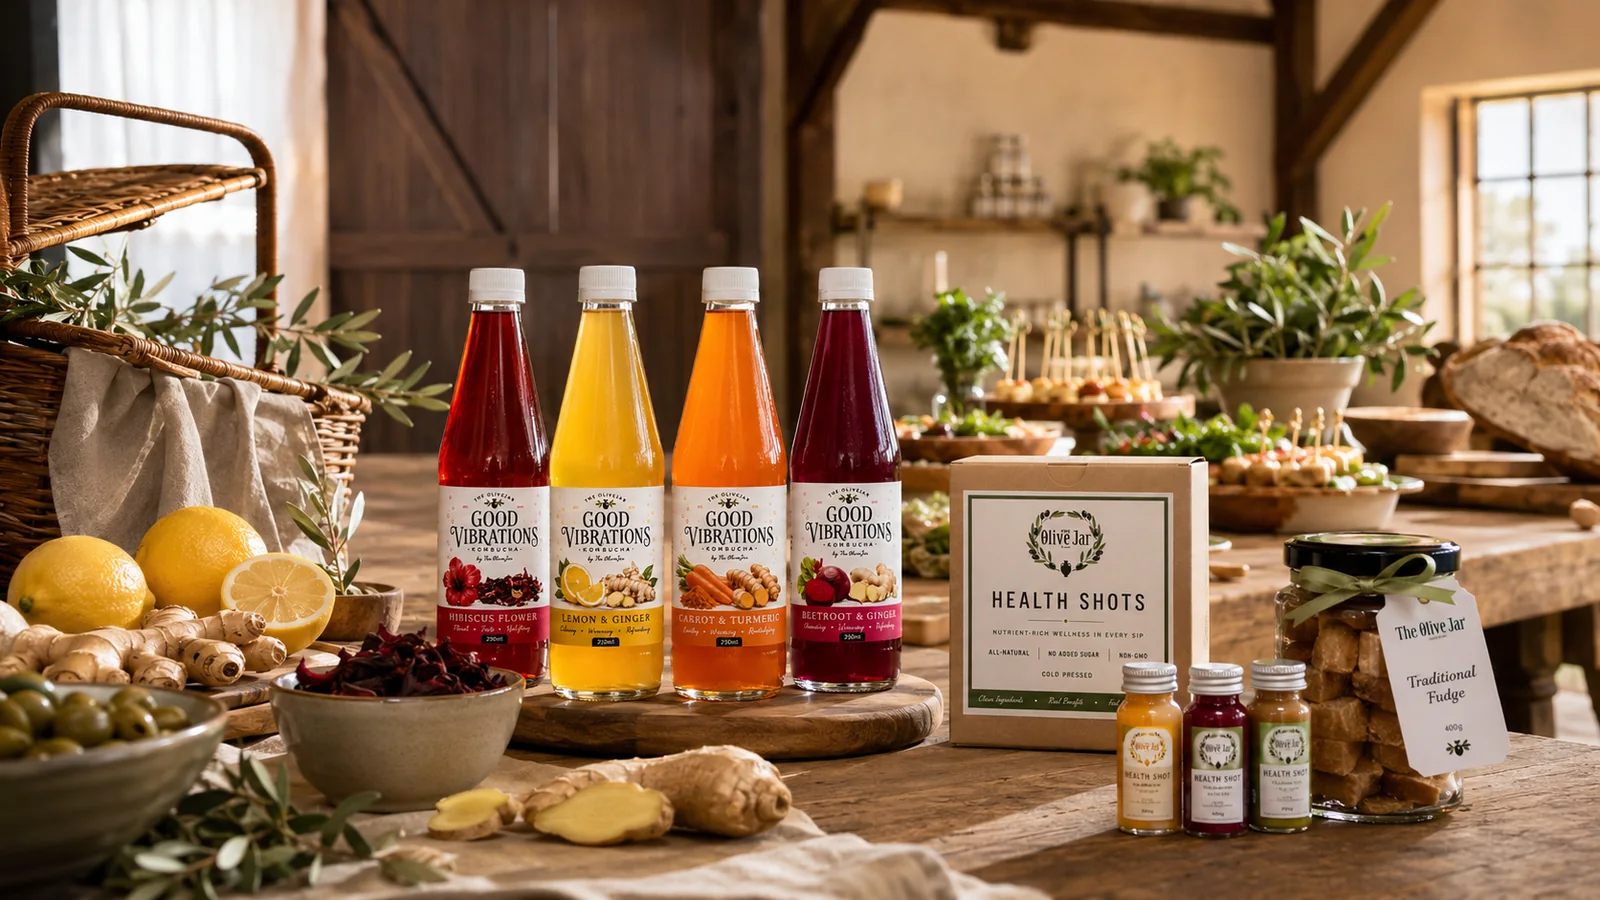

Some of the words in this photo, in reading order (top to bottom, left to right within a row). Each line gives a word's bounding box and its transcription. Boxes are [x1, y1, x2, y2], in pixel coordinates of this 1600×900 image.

[471, 510, 518, 527] GOOD
[583, 511, 630, 528] GOOD
[706, 510, 753, 527] GOOD
[826, 506, 873, 522] GOOD
[450, 526, 539, 547] VIBRATIONS
[561, 526, 651, 548] VIBRATIONS
[684, 526, 774, 547] VIBRATIONS
[805, 521, 892, 543] VIBRATIONS
[1041, 530, 1070, 545] Olive
[1072, 530, 1091, 545] Jar
[992, 591, 1068, 610] HEALTH
[1079, 593, 1146, 611] SHOTS
[449, 613, 494, 622] HIBISCUS
[498, 612, 538, 622] FLOWER
[562, 614, 596, 623] LEMON
[612, 613, 650, 623] GINGER
[678, 614, 715, 624] CARROT
[718, 616, 726, 624] &
[730, 613, 780, 624] TURMERIC
[802, 611, 852, 620] BEETROOT
[856, 612, 863, 620] &
[866, 610, 897, 620] GINGER
[1395, 625, 1418, 640] The
[1419, 620, 1447, 636] Olive
[1448, 617, 1466, 632] Jar
[1406, 665, 1477, 689] Traditional
[1426, 688, 1466, 704] Fudge
[1124, 771, 1150, 780] HEALTH
[1153, 772, 1170, 780] SHOT
[1194, 774, 1221, 783] HEALTH
[1224, 774, 1241, 783] SHOT
[1293, 769, 1308, 777] SHOT
